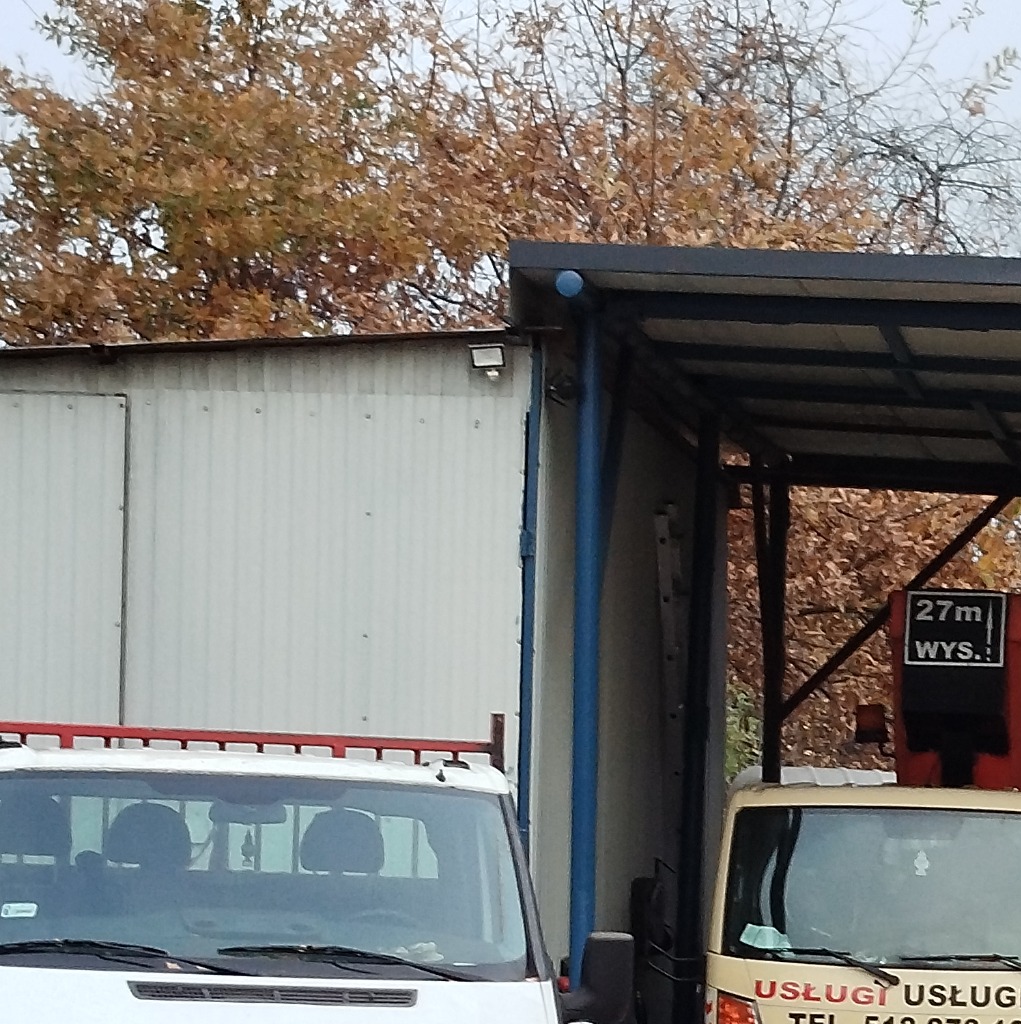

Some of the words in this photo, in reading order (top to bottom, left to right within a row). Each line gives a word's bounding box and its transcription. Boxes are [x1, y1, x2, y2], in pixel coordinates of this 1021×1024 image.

[915, 599, 982, 622] 27m
[915, 640, 981, 660] WYS.
[755, 980, 887, 1006] USŁUGI
